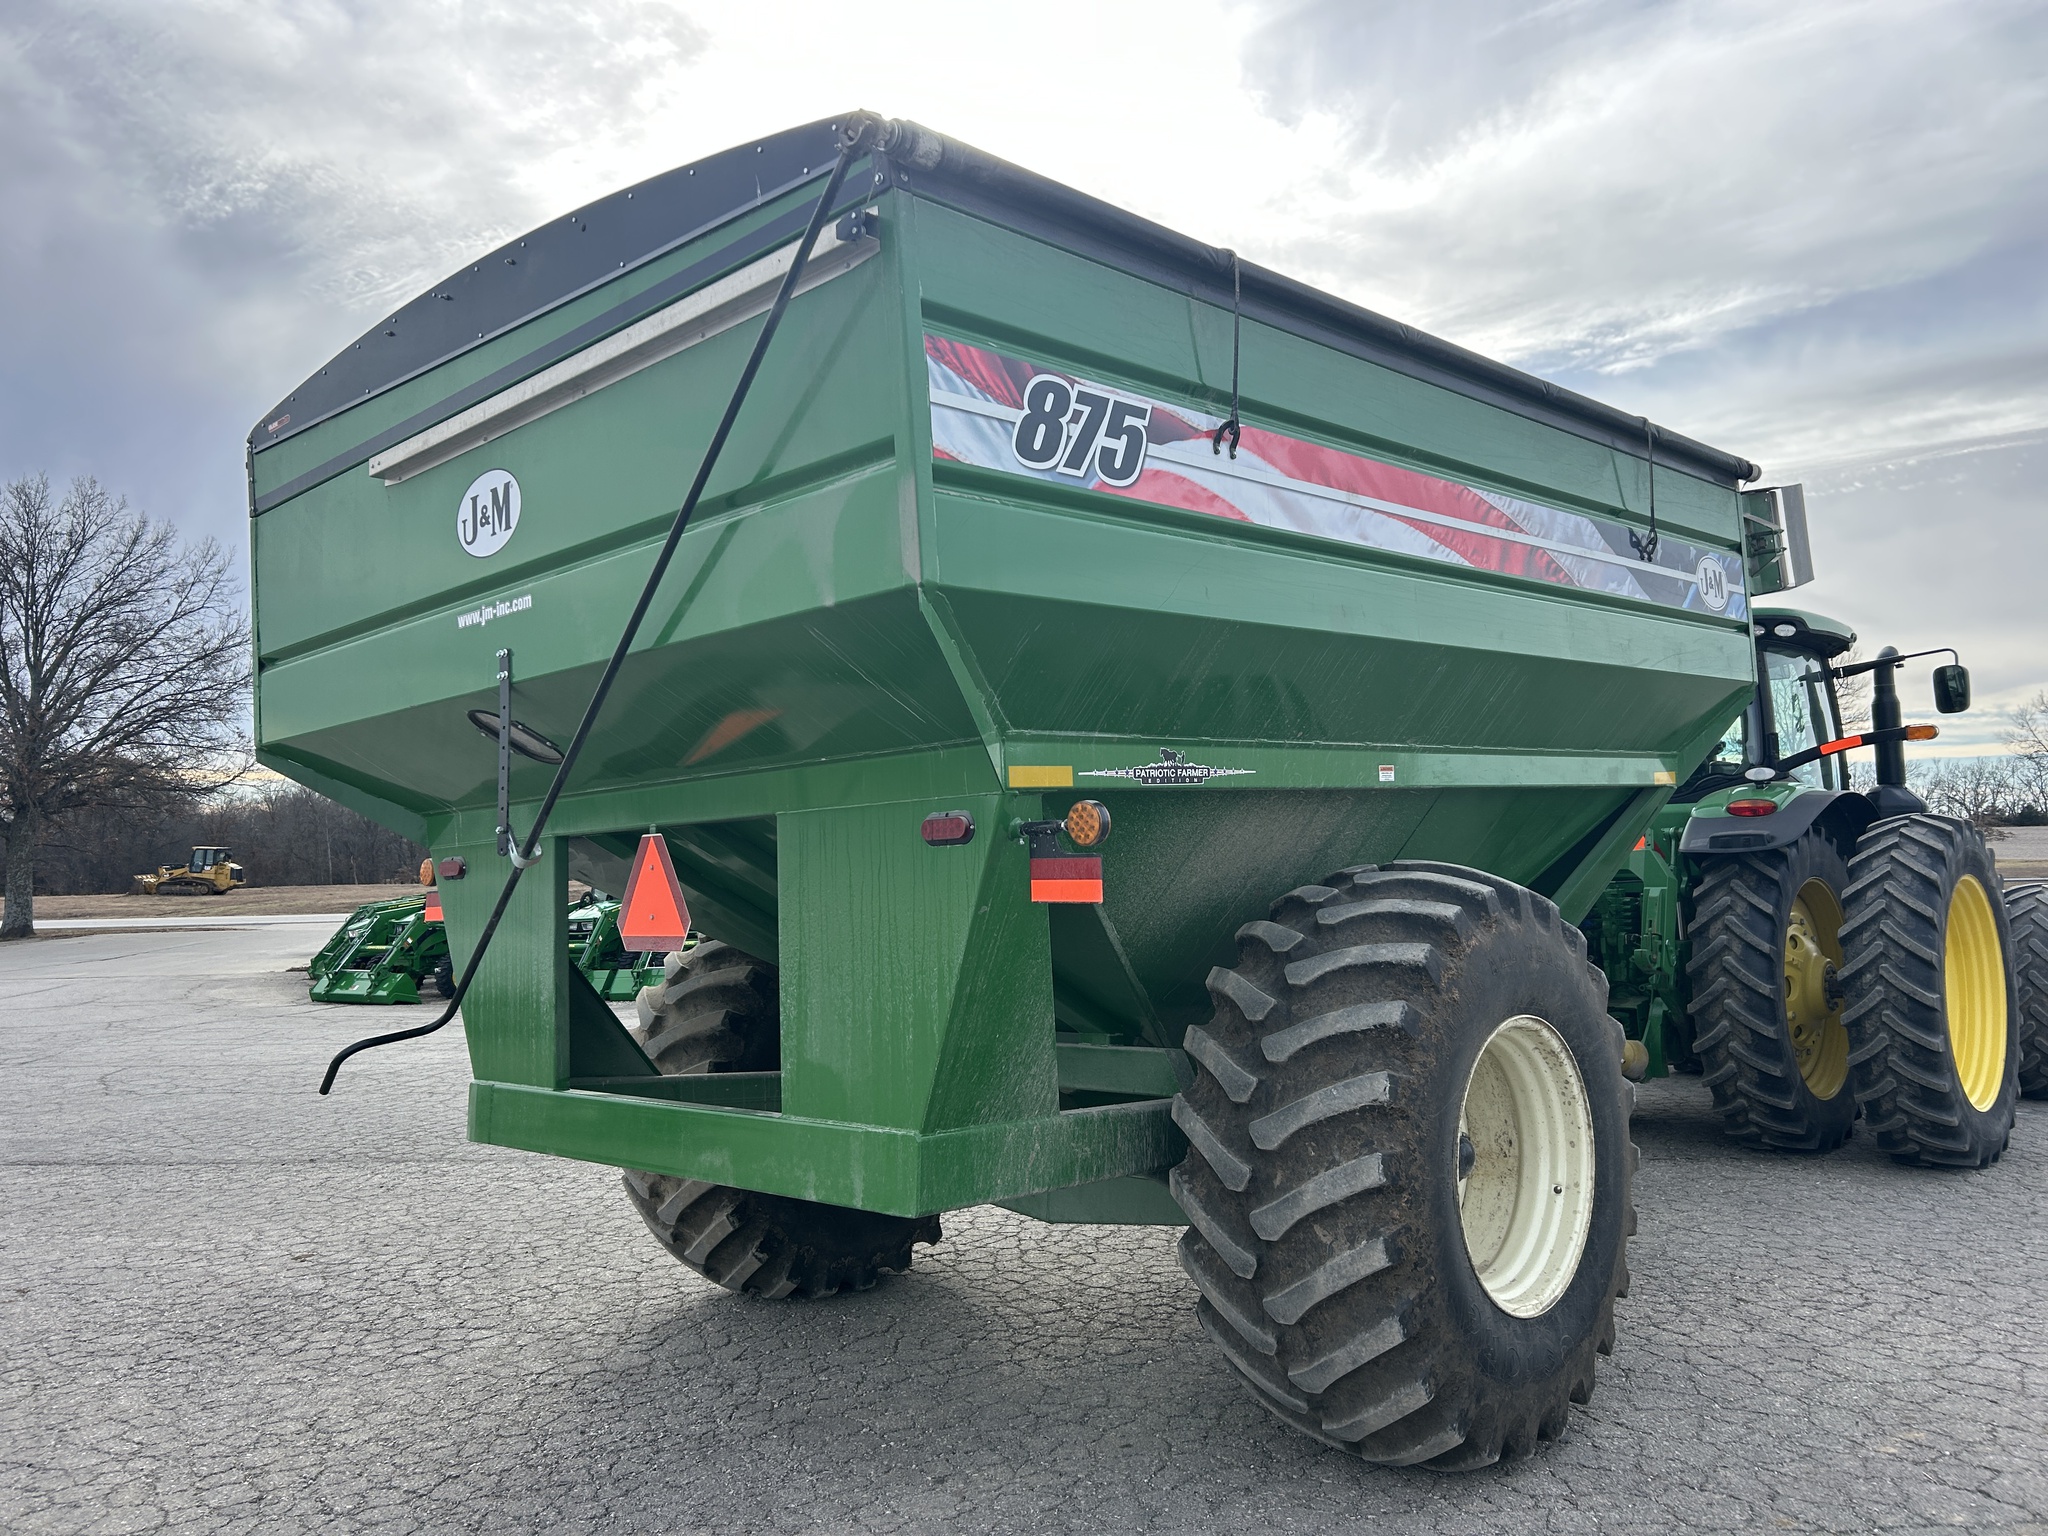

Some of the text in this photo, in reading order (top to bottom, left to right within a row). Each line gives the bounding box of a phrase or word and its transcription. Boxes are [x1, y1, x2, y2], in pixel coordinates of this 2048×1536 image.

[1013, 375, 1151, 486] 875
[461, 480, 513, 546] J&M
[1700, 567, 1725, 600] J&M
[457, 594, 532, 628] www.jm-inc.com
[1135, 768, 1209, 777] PATRIOTIC FARMER
